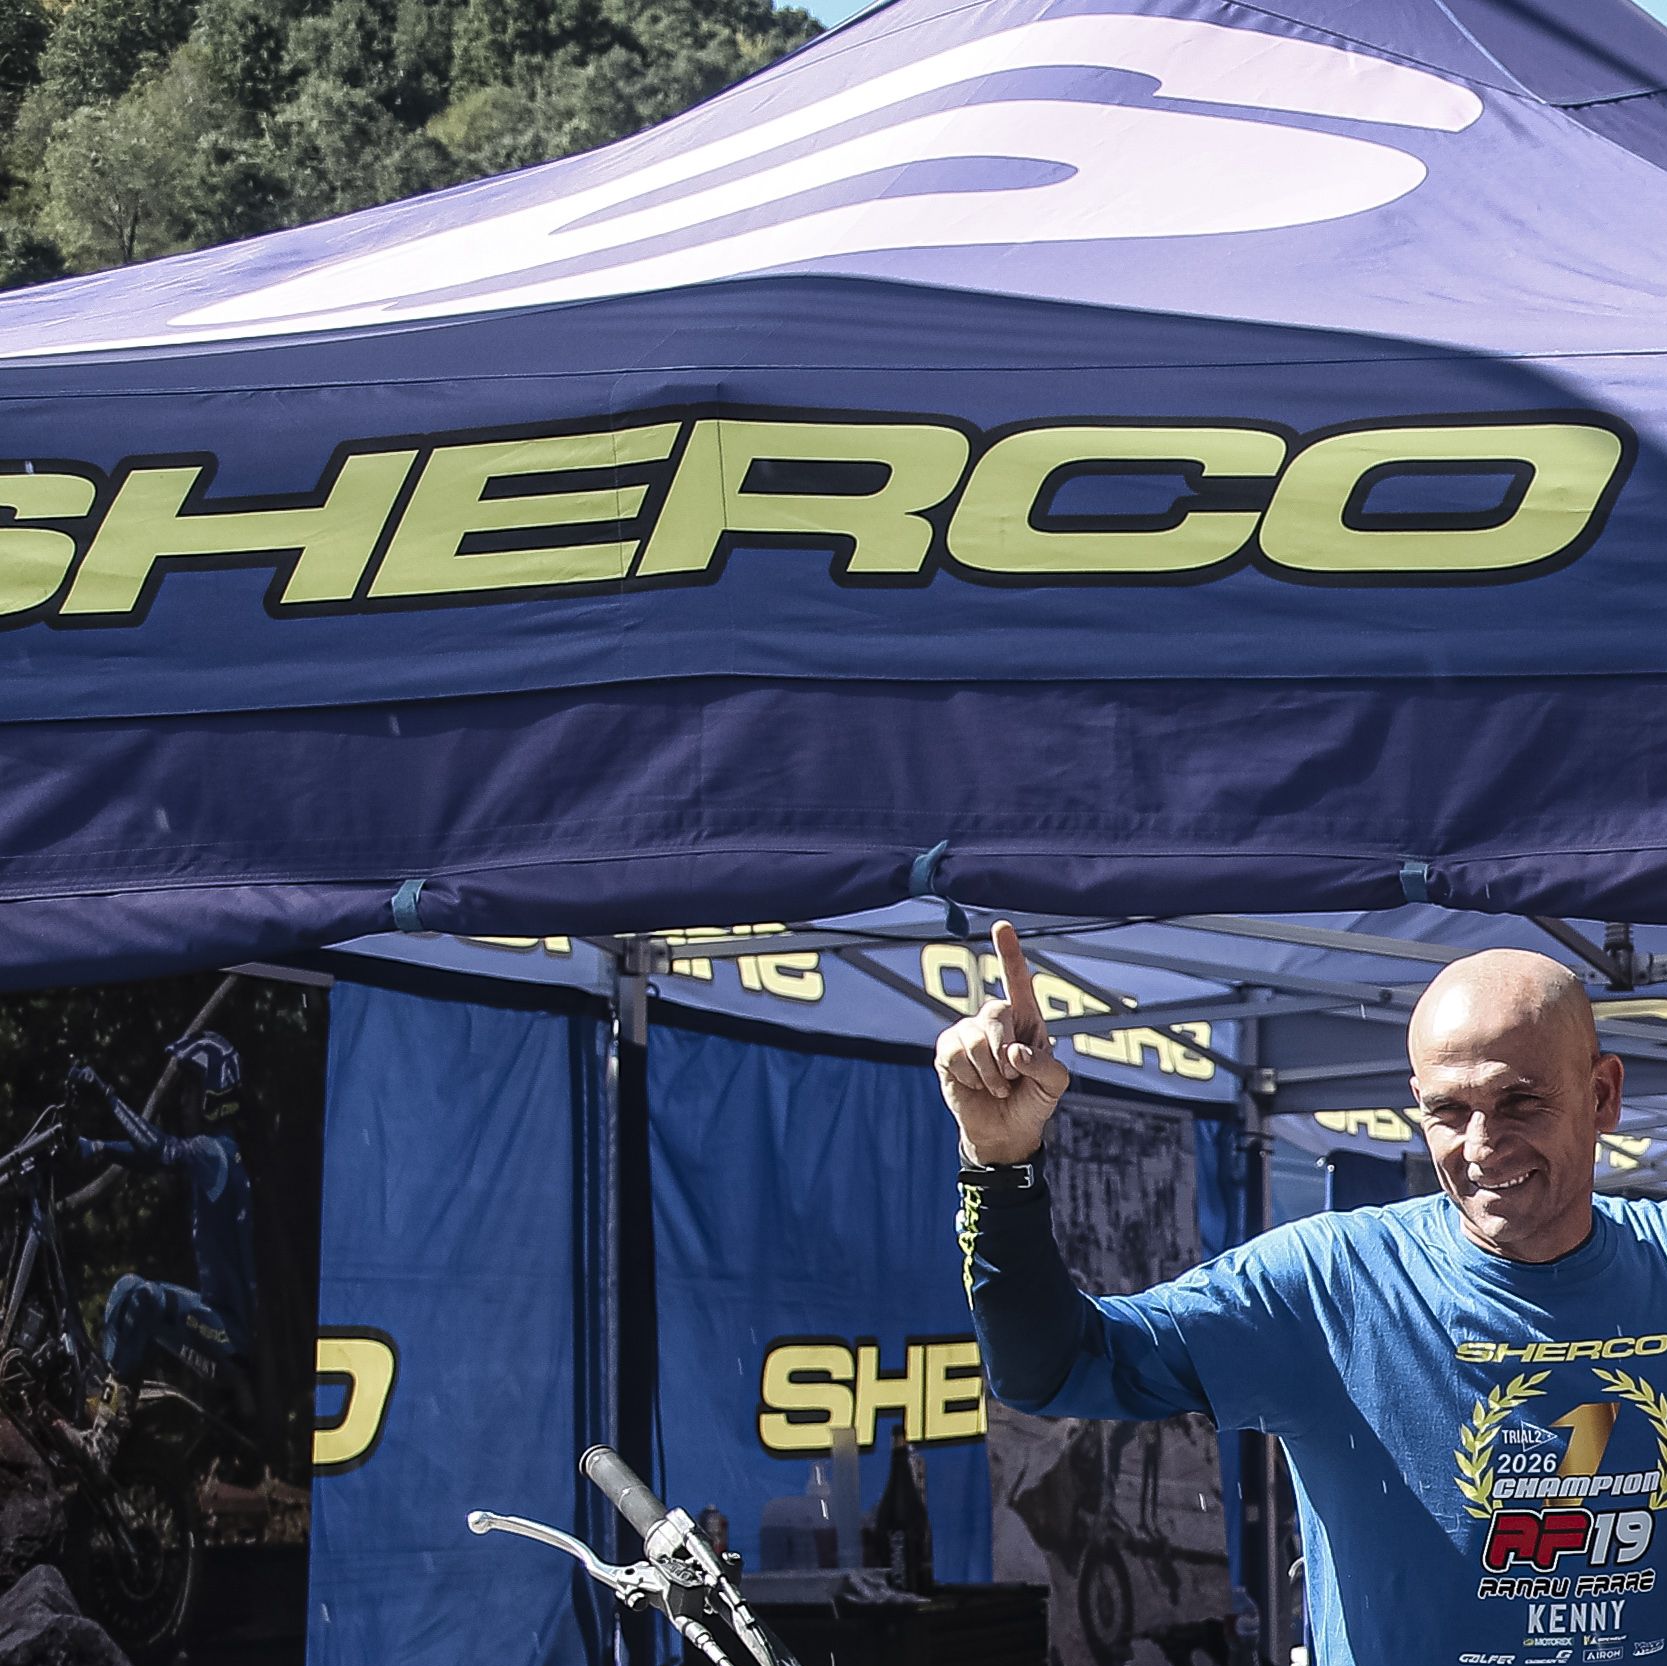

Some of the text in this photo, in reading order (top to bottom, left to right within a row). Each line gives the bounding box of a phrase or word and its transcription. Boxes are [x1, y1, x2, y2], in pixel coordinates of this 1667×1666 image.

[1502, 1429, 1542, 1445] TRIAL2
[1497, 1453, 1557, 1474] 2026
[1492, 1470, 1661, 1500] CHAMPION
[1527, 1600, 1626, 1634] KENNY
